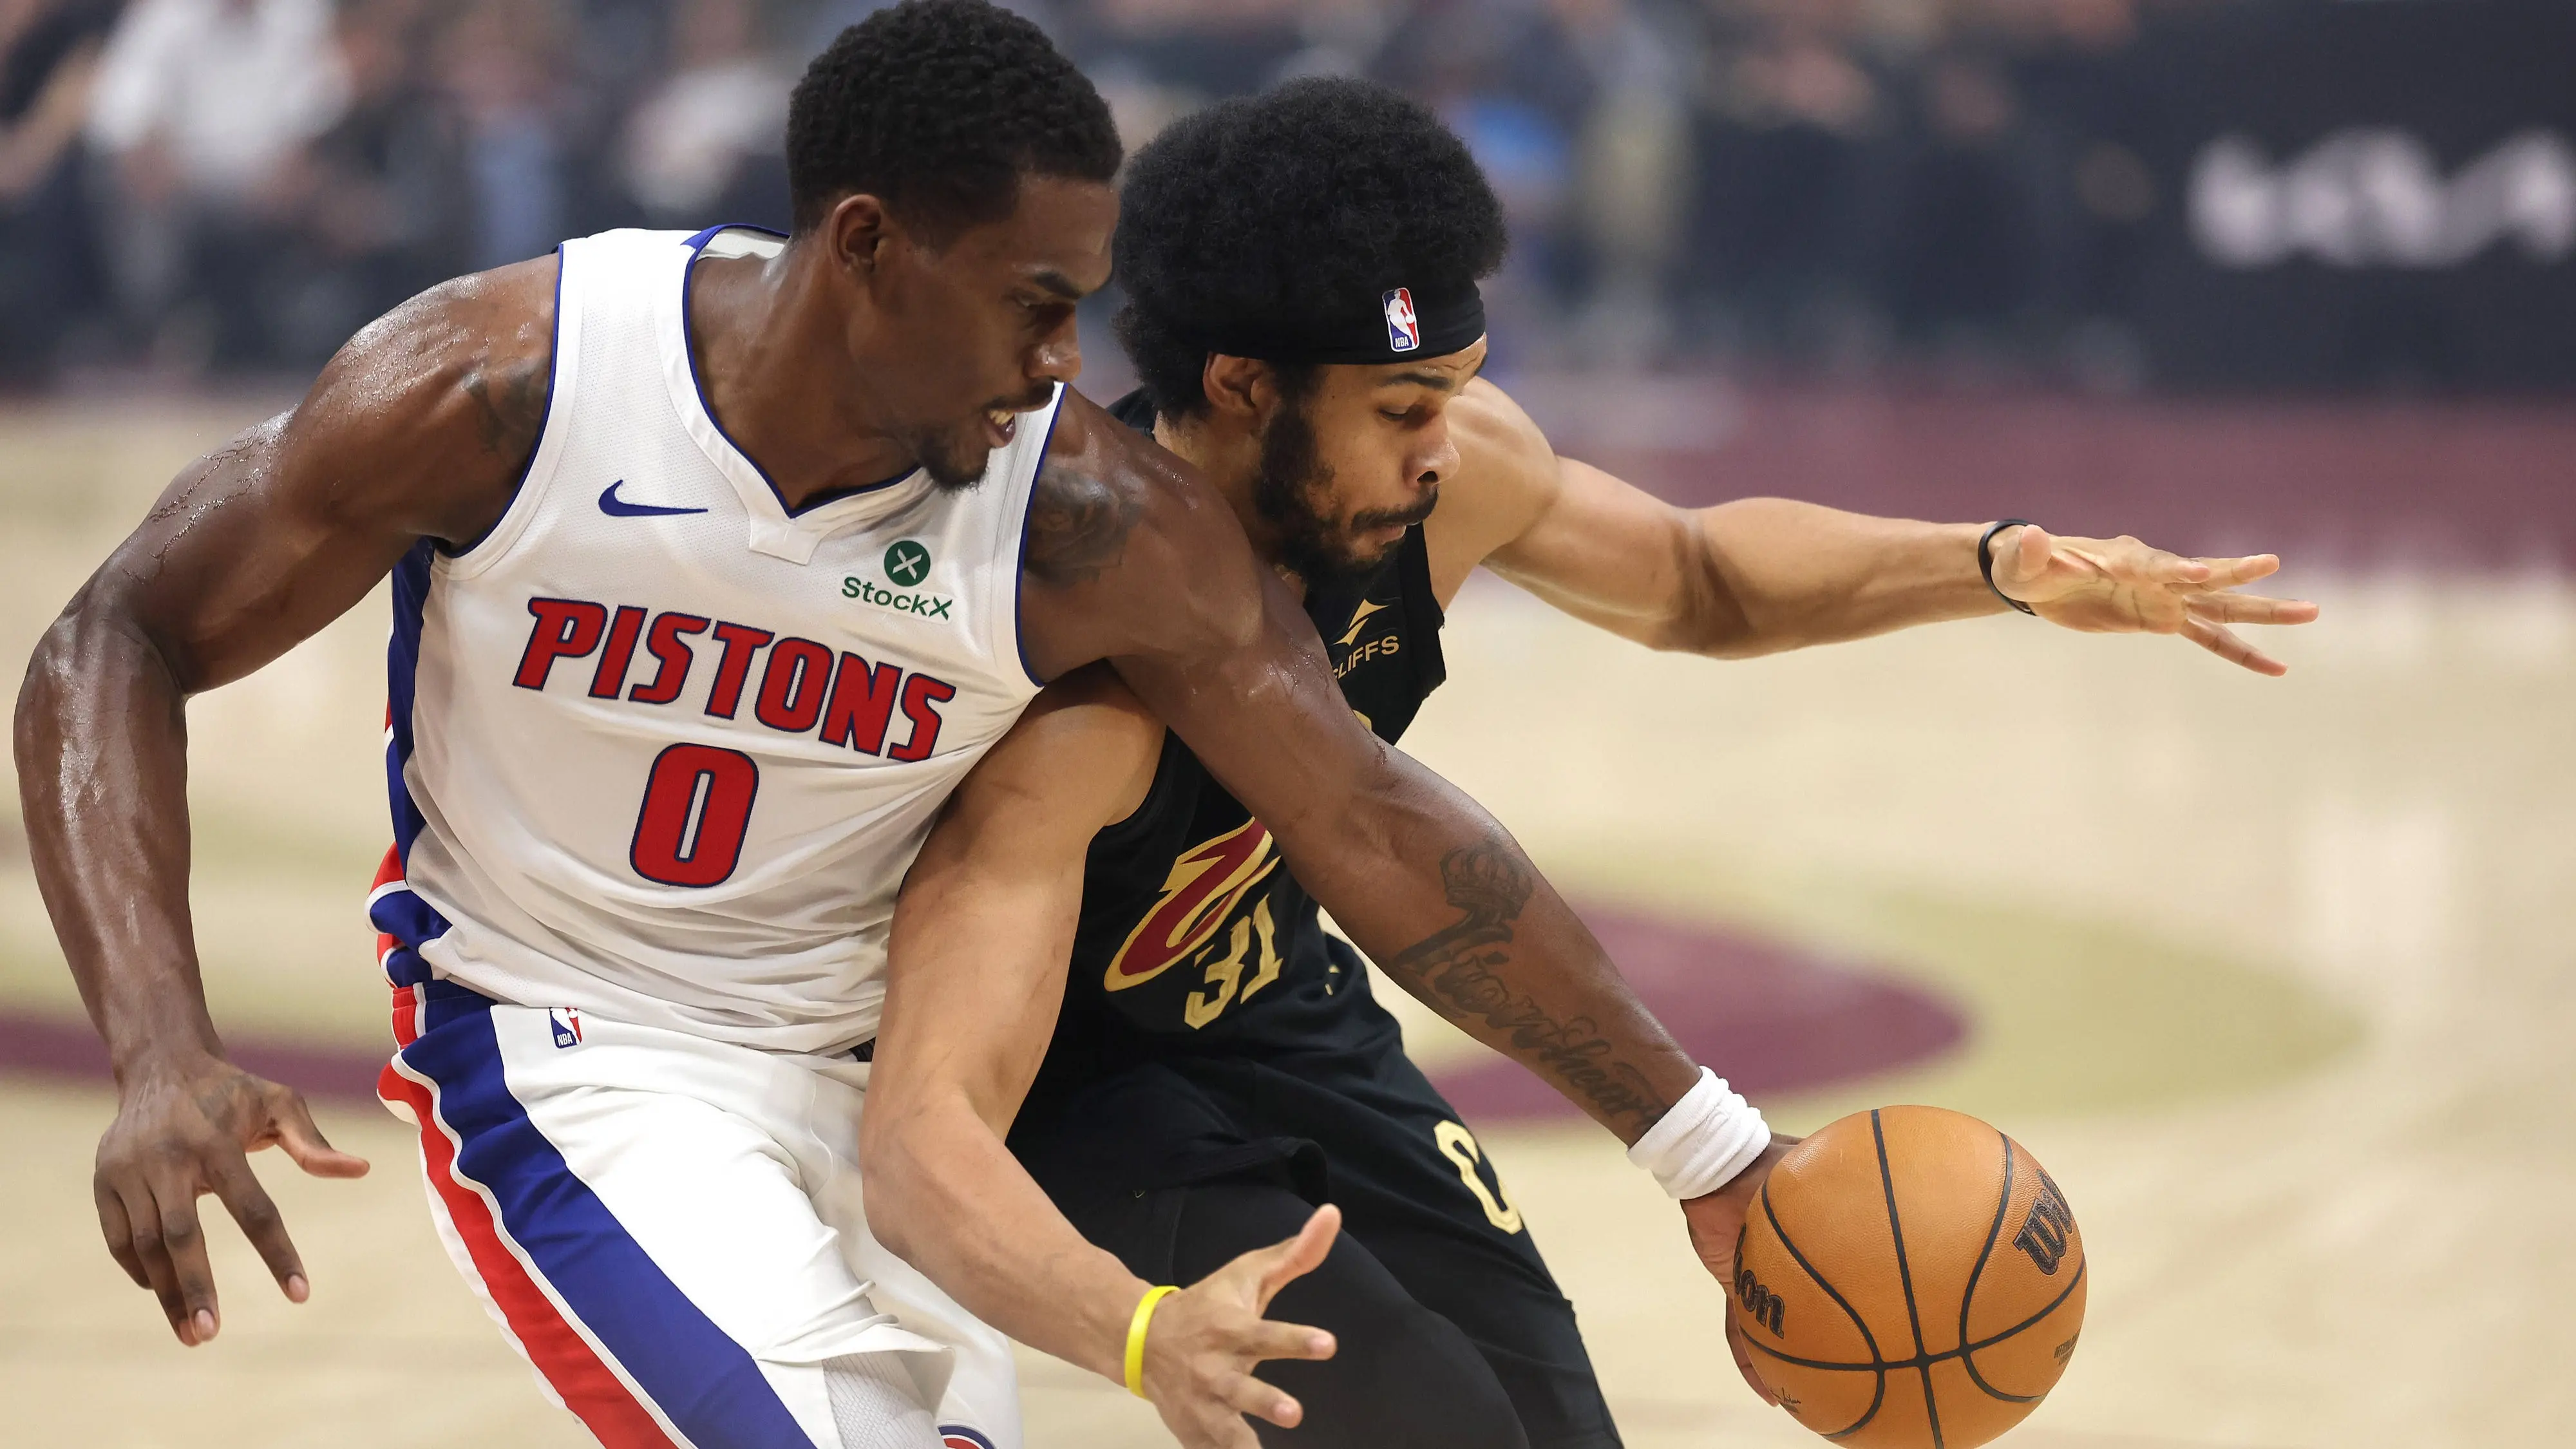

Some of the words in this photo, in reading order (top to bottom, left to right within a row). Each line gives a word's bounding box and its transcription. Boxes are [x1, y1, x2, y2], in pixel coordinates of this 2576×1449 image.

[1395, 336, 1409, 348] NBA
[842, 576, 953, 621] StockX
[513, 597, 957, 762] PISTONS
[629, 743, 759, 888] 0
[1184, 891, 1283, 1030] 31
[557, 1032, 573, 1046] NBA
